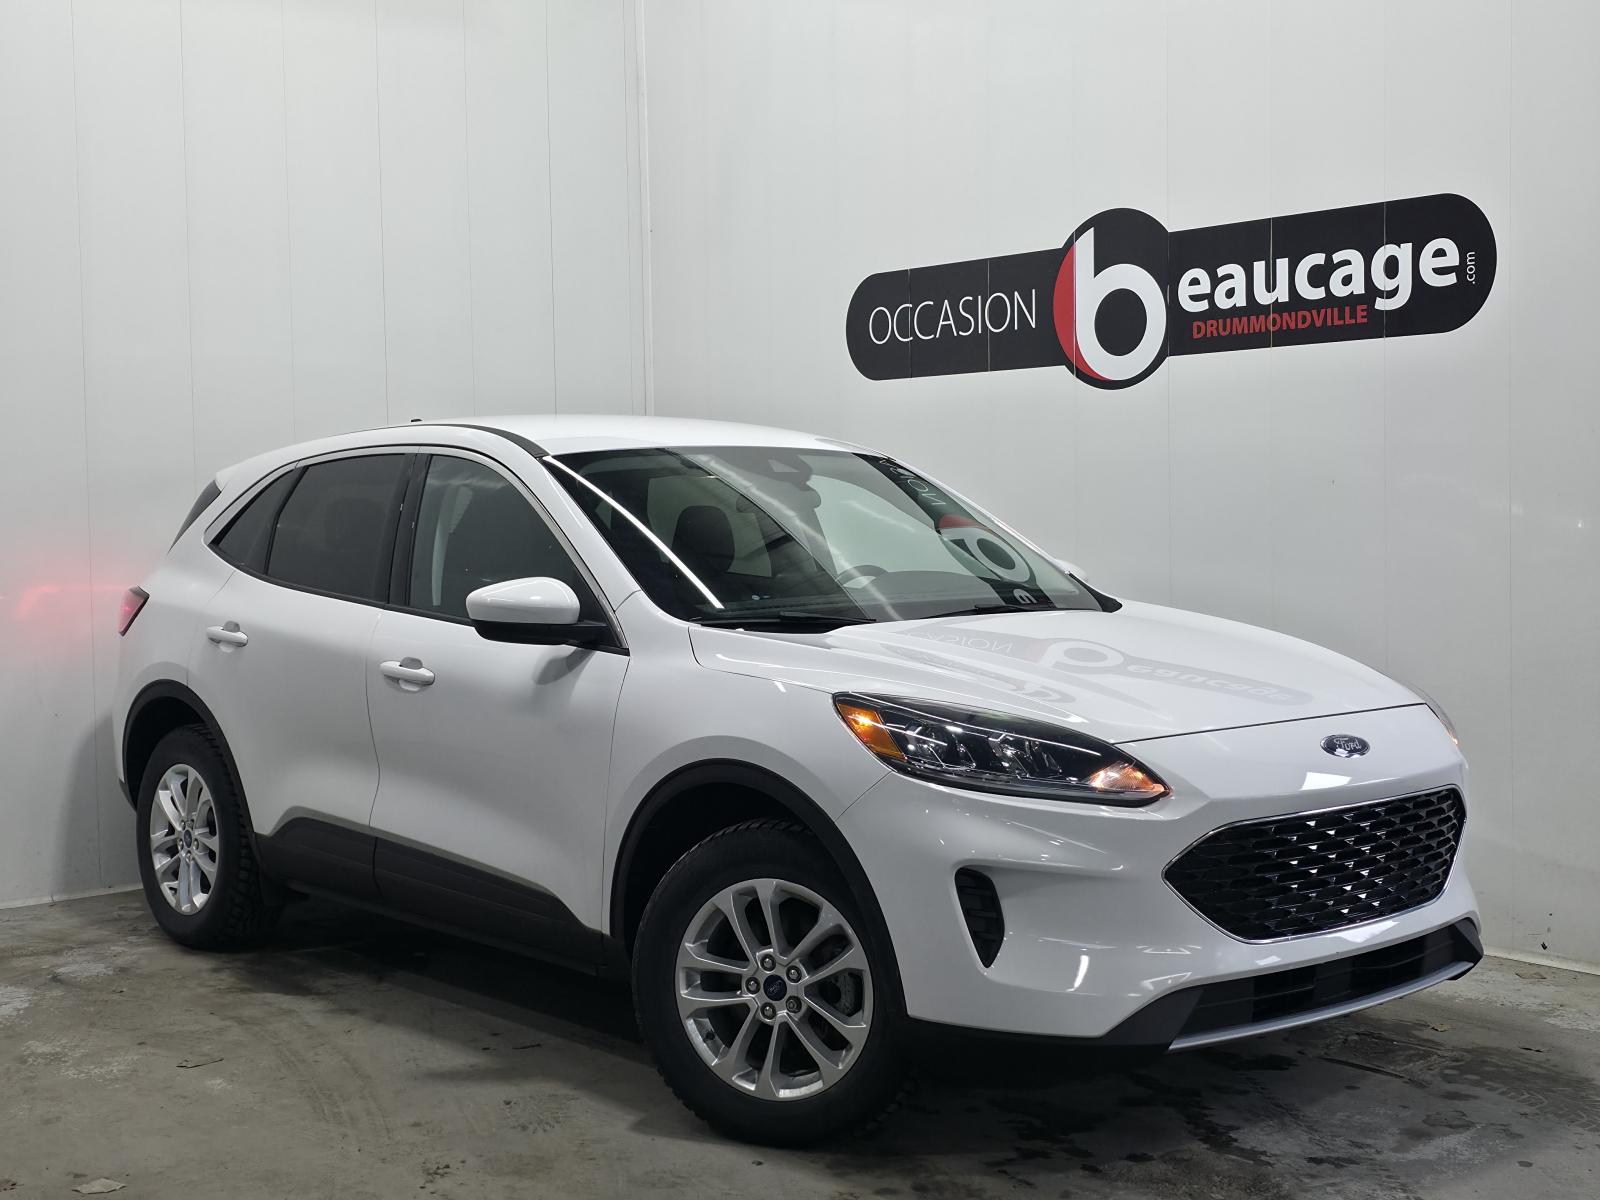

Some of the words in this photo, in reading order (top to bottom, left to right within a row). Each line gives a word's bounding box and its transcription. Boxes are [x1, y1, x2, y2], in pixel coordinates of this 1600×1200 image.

[1465, 251, 1476, 285] .com
[868, 288, 1036, 345] OCCASION
[1192, 304, 1368, 339] DRUMMONDVILLE
[1333, 737, 1362, 751] Ford
